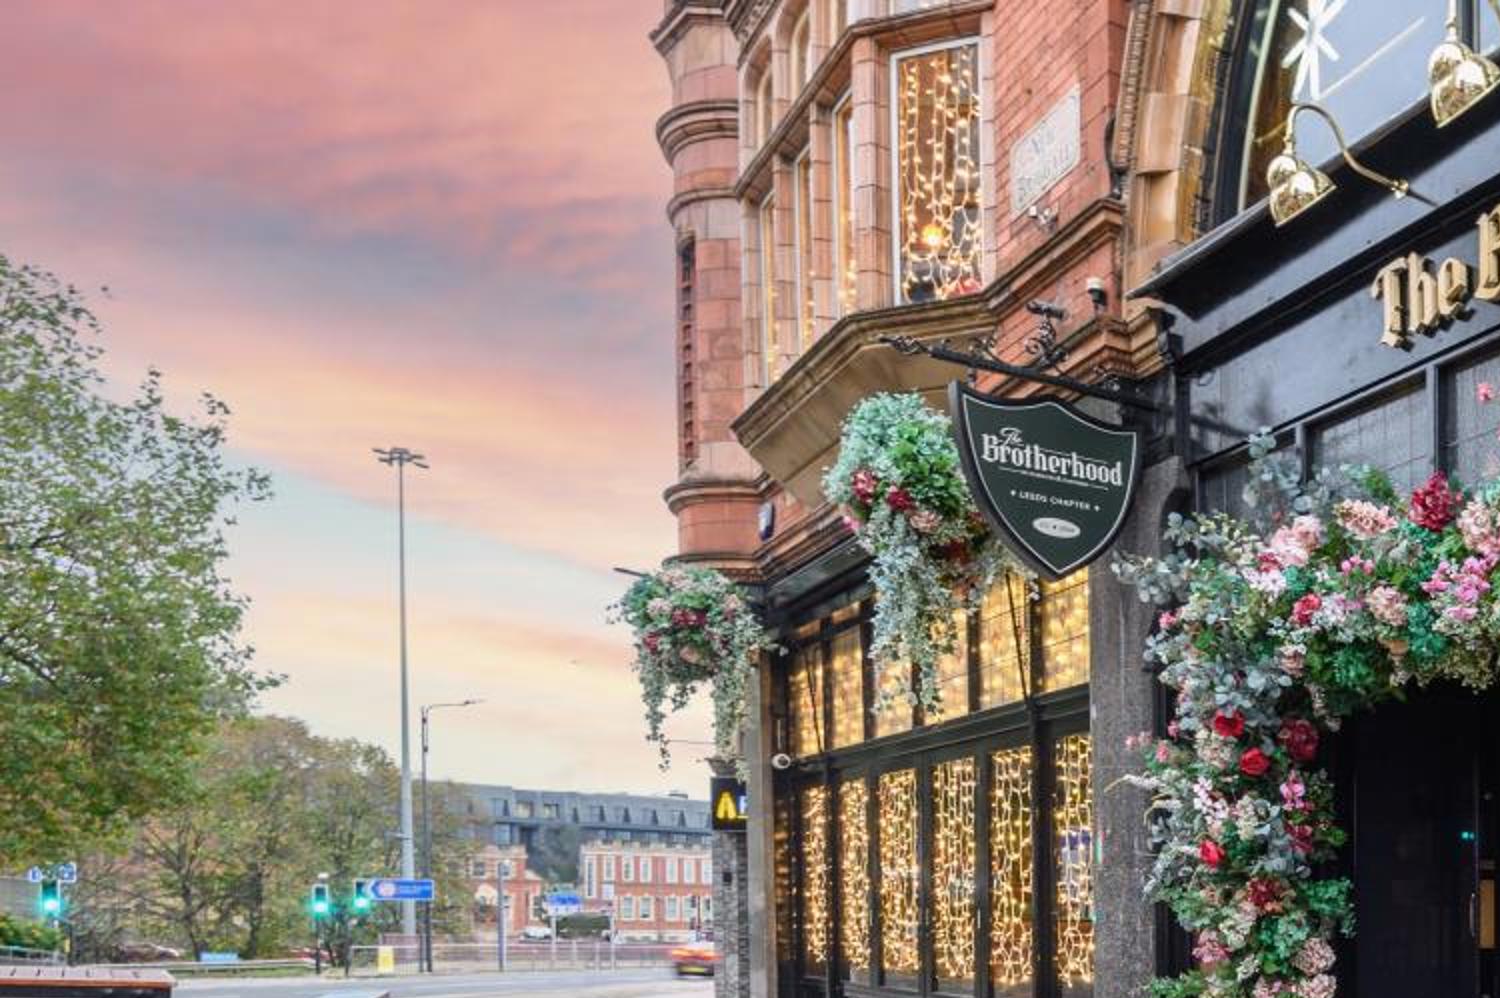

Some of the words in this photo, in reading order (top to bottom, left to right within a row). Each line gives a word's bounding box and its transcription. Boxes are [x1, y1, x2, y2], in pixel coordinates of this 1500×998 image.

[1371, 251, 1468, 349] The
[981, 433, 1123, 487] Brotherhood
[1000, 427, 1024, 446] The
